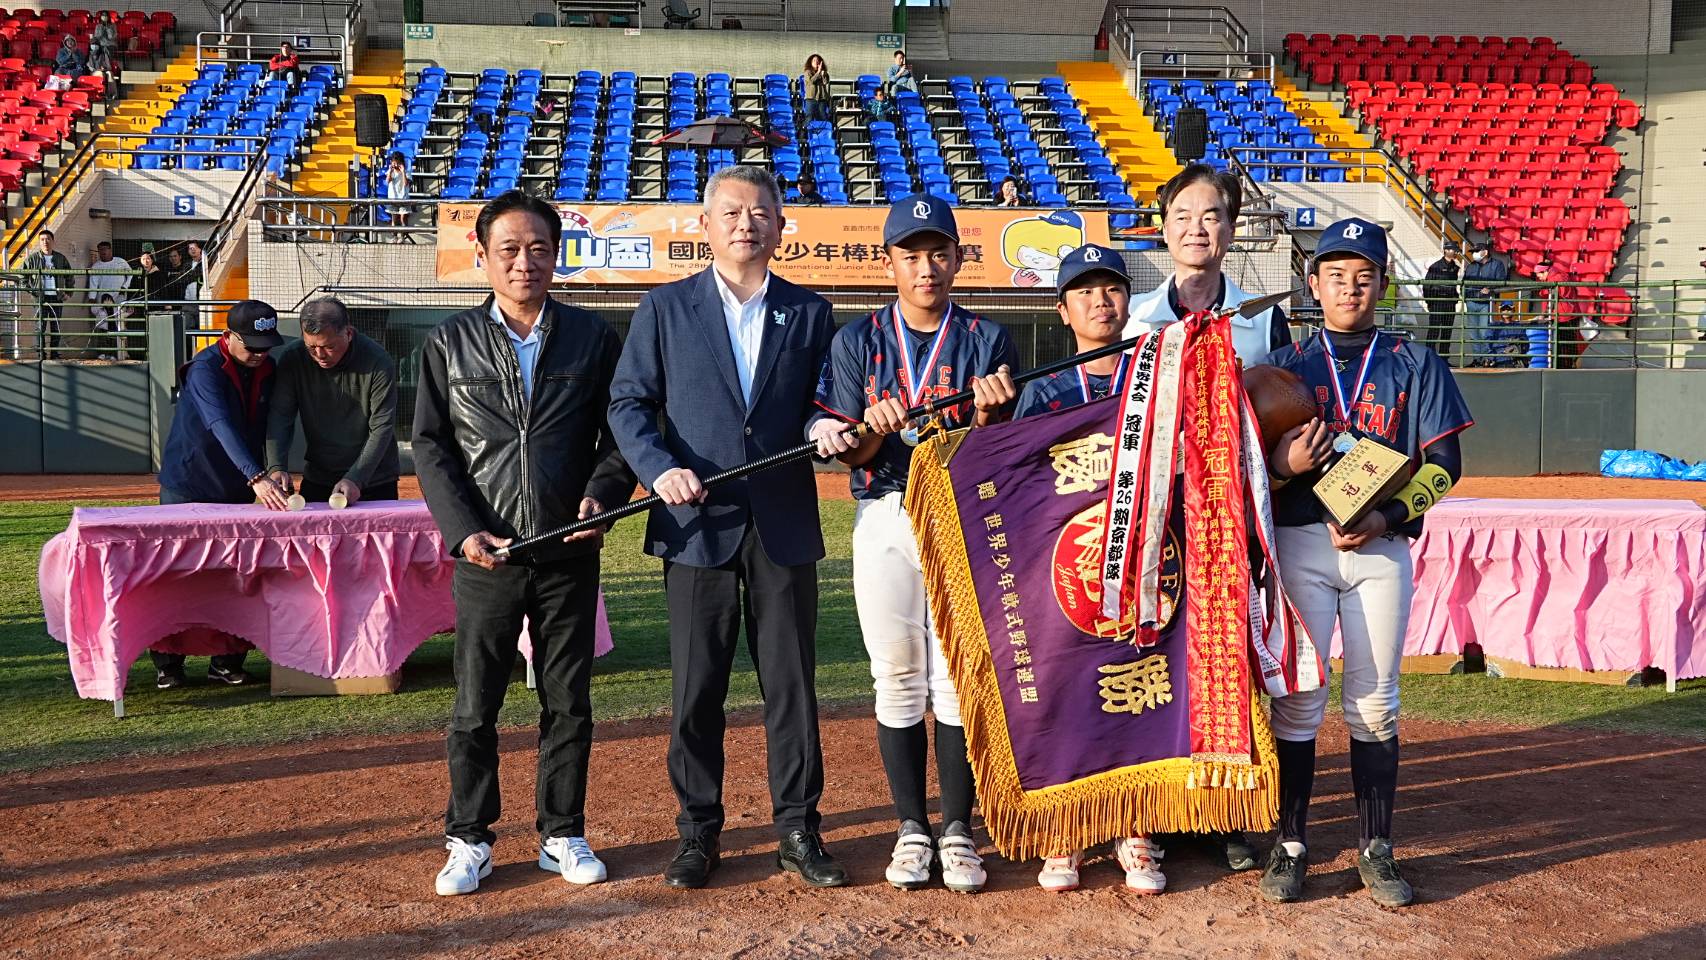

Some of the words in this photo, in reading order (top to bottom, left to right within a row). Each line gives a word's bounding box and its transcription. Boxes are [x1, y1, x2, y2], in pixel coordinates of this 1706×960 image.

[1165, 54, 1175, 64] 4
[131, 117, 147, 125] 10
[178, 197, 191, 213] 5
[1300, 210, 1311, 224] 4
[959, 227, 982, 237] 迎您
[776, 260, 833, 270] International
[836, 260, 865, 271] Junior
[867, 260, 885, 271] Bas
[1122, 414, 1143, 452] 冠軍
[1202, 447, 1230, 510] 冠軍
[1055, 562, 1078, 609] Japan
